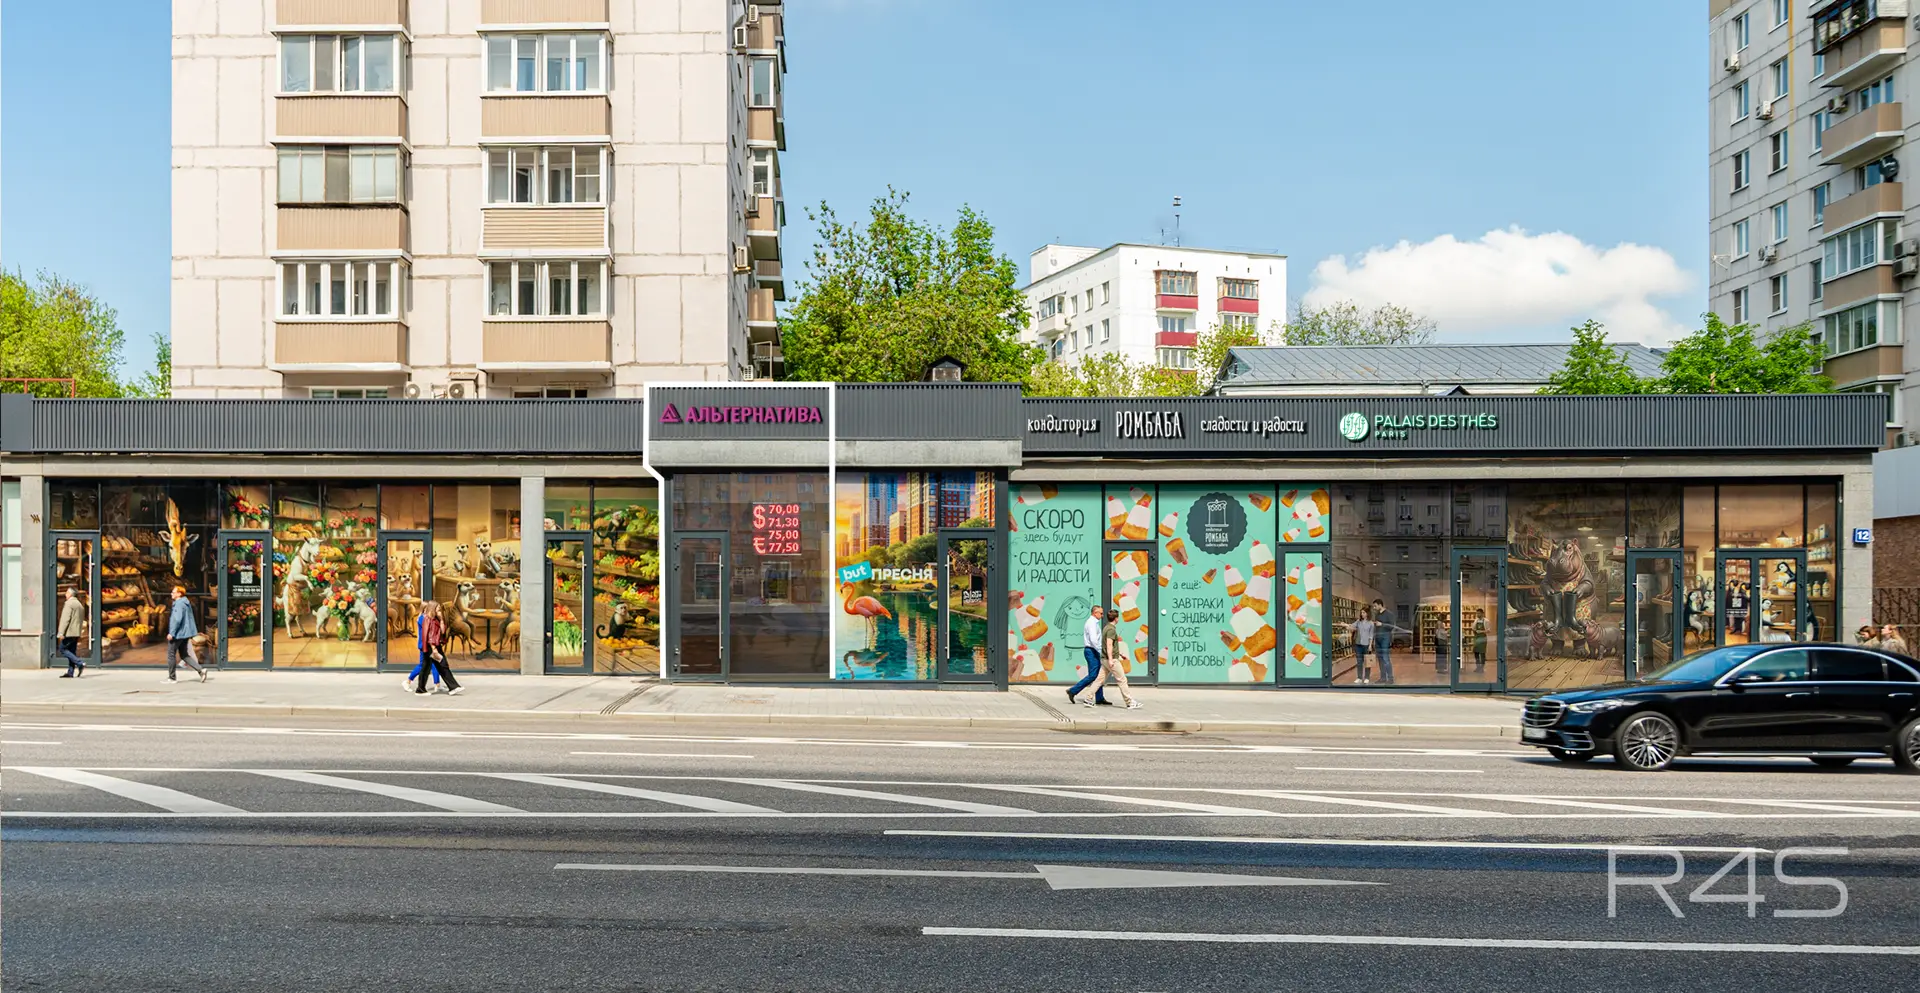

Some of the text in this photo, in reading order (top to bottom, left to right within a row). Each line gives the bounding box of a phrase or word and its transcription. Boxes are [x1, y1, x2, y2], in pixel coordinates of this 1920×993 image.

[686, 406, 822, 423] АЛЬТЕРНАТИВА
[1374, 412, 1497, 427] PALAIS DES THÉS
[1027, 414, 1097, 435] кондитория
[1116, 410, 1182, 437] РОМБАБА
[1200, 415, 1304, 437] сладости и радости
[1374, 430, 1406, 438] PARIS
[768, 504, 799, 516] 70,00
[768, 517, 799, 528] 71,30
[1023, 508, 1085, 530] СКОРО
[768, 530, 799, 541] 75,00
[1024, 530, 1084, 545] здесь будут
[1205, 532, 1229, 543] РОМБАБА
[1857, 530, 1869, 540] 12
[768, 542, 799, 553] 77,50
[1019, 551, 1089, 566] СЛАДОСТИ
[843, 565, 867, 580] but
[871, 568, 933, 581] ПРЕСНЯ
[1017, 568, 1090, 584] И РАДОСТИ
[1172, 580, 1202, 590] а ещё:
[1172, 597, 1224, 609] ЗАВТРАКИ
[1171, 612, 1225, 624] СЭНДВИЧИ
[1171, 626, 1201, 638] КОФЕ
[1172, 640, 1206, 652] ТОРТЫ
[1171, 655, 1226, 667] И ЛЮБОВЬ!
